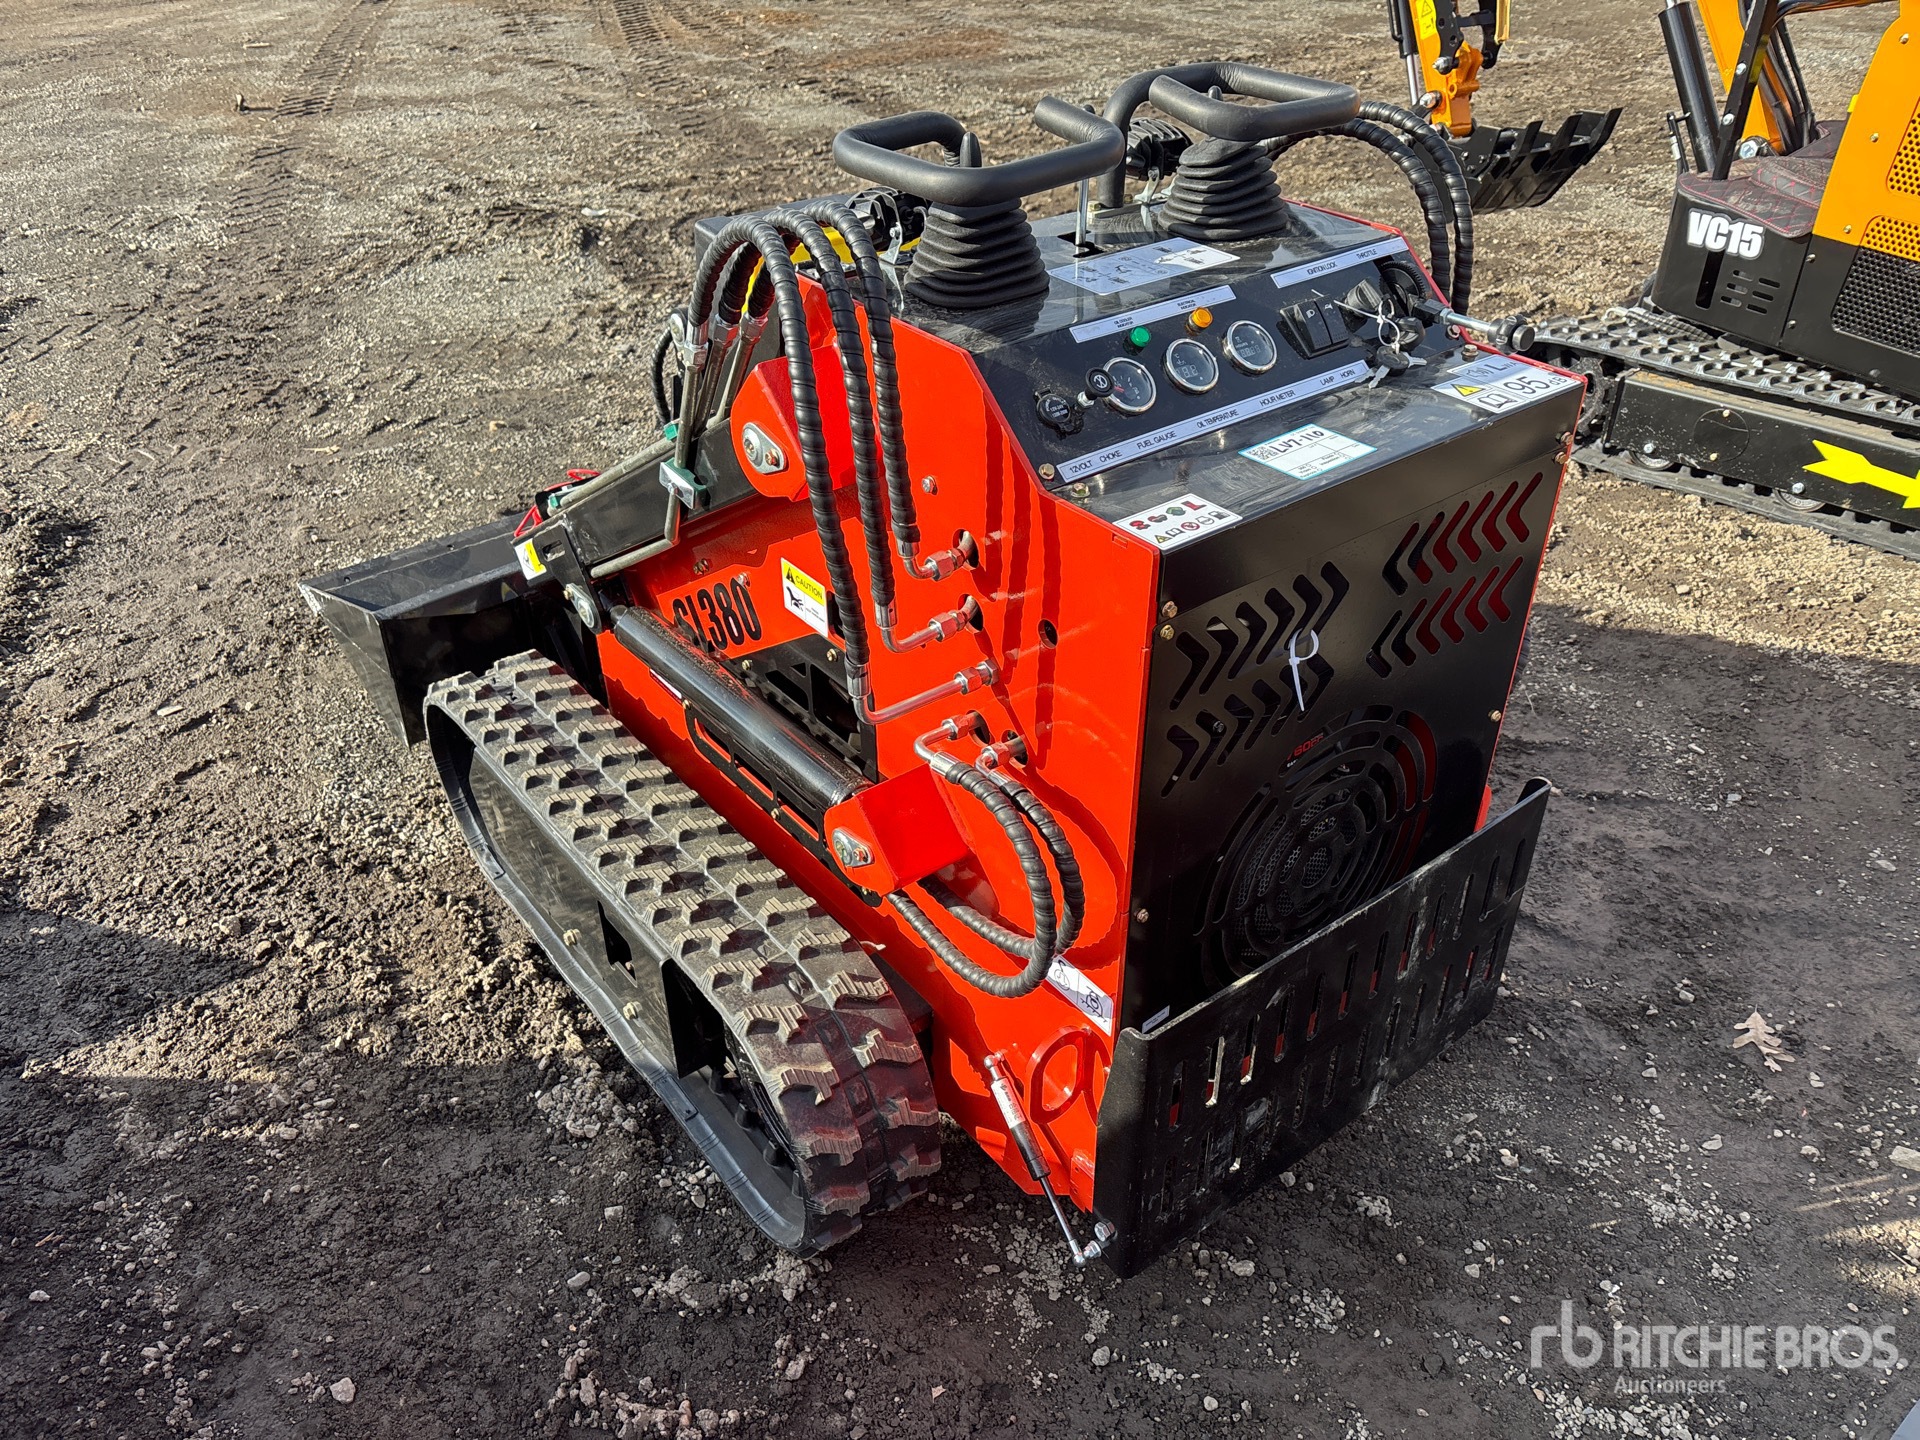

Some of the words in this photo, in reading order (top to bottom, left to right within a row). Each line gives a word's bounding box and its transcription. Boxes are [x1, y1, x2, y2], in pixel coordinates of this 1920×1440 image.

[1688, 210, 1765, 260] VC15
[1356, 248, 1378, 259] THROTTLE
[1503, 376, 1550, 395] 95
[1548, 376, 1568, 386] dB
[1069, 460, 1093, 474] 12VOLT
[1099, 449, 1123, 463] CHOKE
[1136, 440, 1155, 450] FUEL
[1153, 430, 1178, 444] GAUGE
[1196, 420, 1206, 429] OIL
[1204, 408, 1239, 427] TEMPERATURE
[1259, 397, 1276, 407] HOUR
[1275, 389, 1296, 401] METER
[1320, 375, 1335, 386] LAMP
[1340, 368, 1355, 379] HORN
[795, 574, 823, 600] CAUTION
